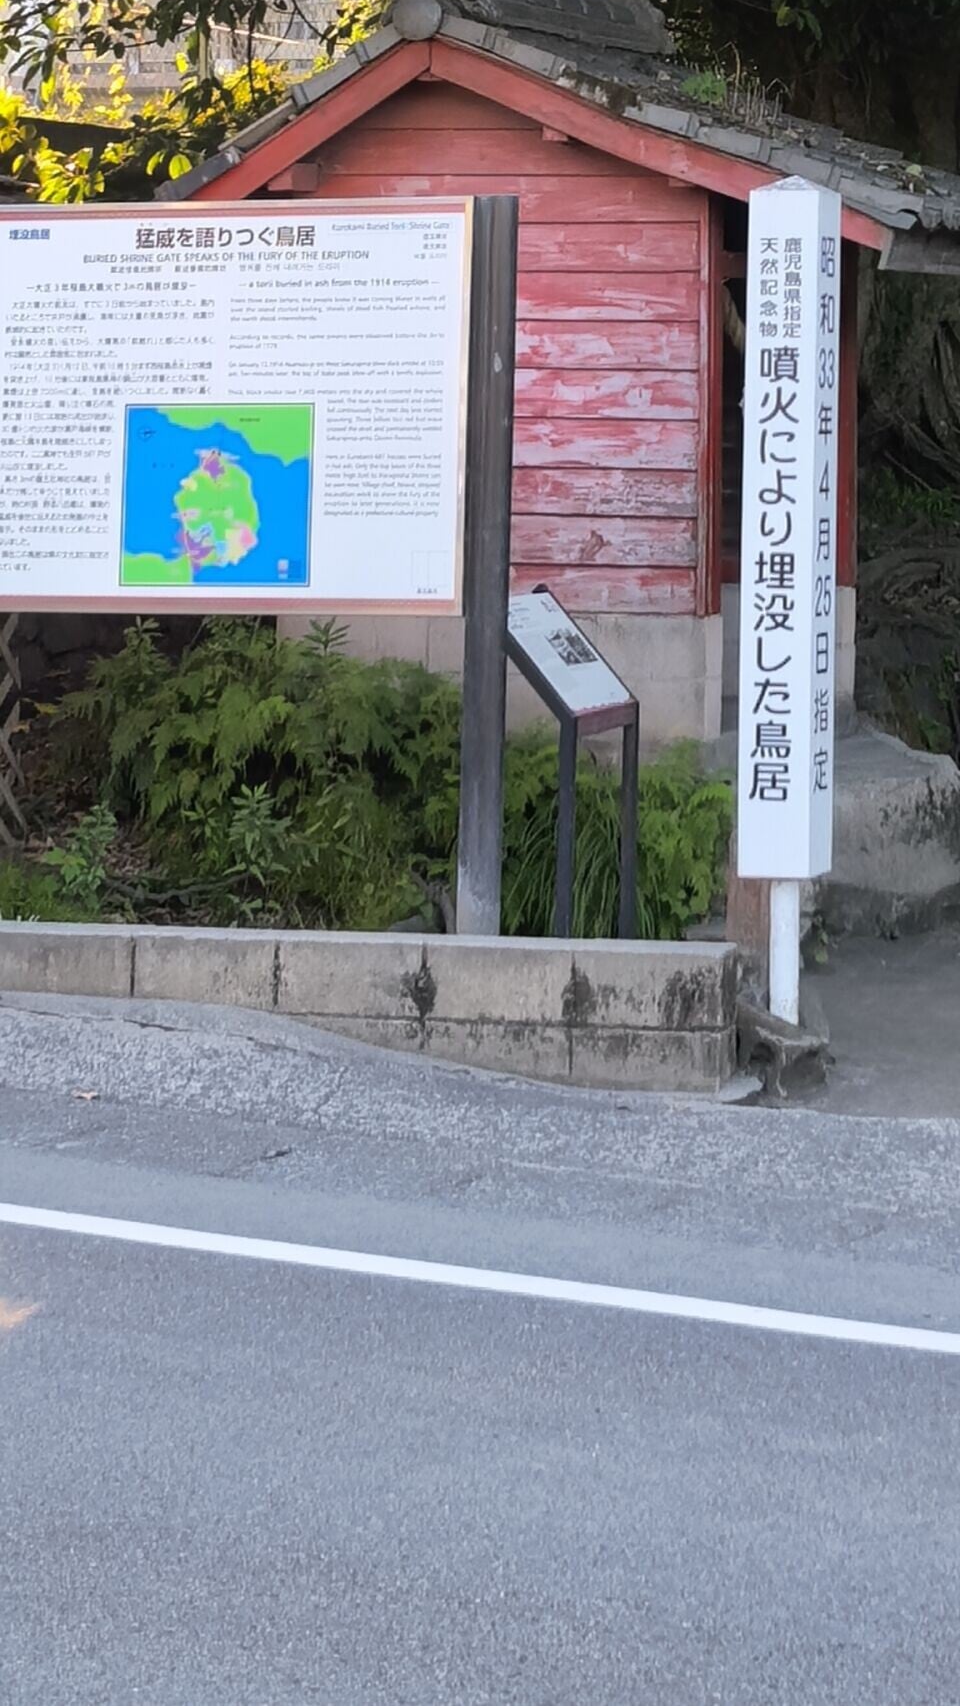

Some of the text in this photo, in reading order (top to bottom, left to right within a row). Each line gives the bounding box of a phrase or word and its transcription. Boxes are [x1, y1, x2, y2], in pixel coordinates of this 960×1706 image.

[83, 250, 370, 264] BURIED SHRINE GATE SPEAKS OF THE FURY OF THE ERUPTION
[135, 226, 316, 250] 猛威を語りつぐ鳥居
[275, 280, 302, 288] buried
[304, 279, 312, 287] in
[314, 279, 329, 287] ash
[392, 278, 429, 287] eruption
[759, 237, 779, 338] 天然記念物
[782, 237, 803, 339] 鹿児島県指定
[812, 235, 836, 796] 昭和33年4月25日指定
[748, 345, 800, 803] 噴火により埋没した鳥居
